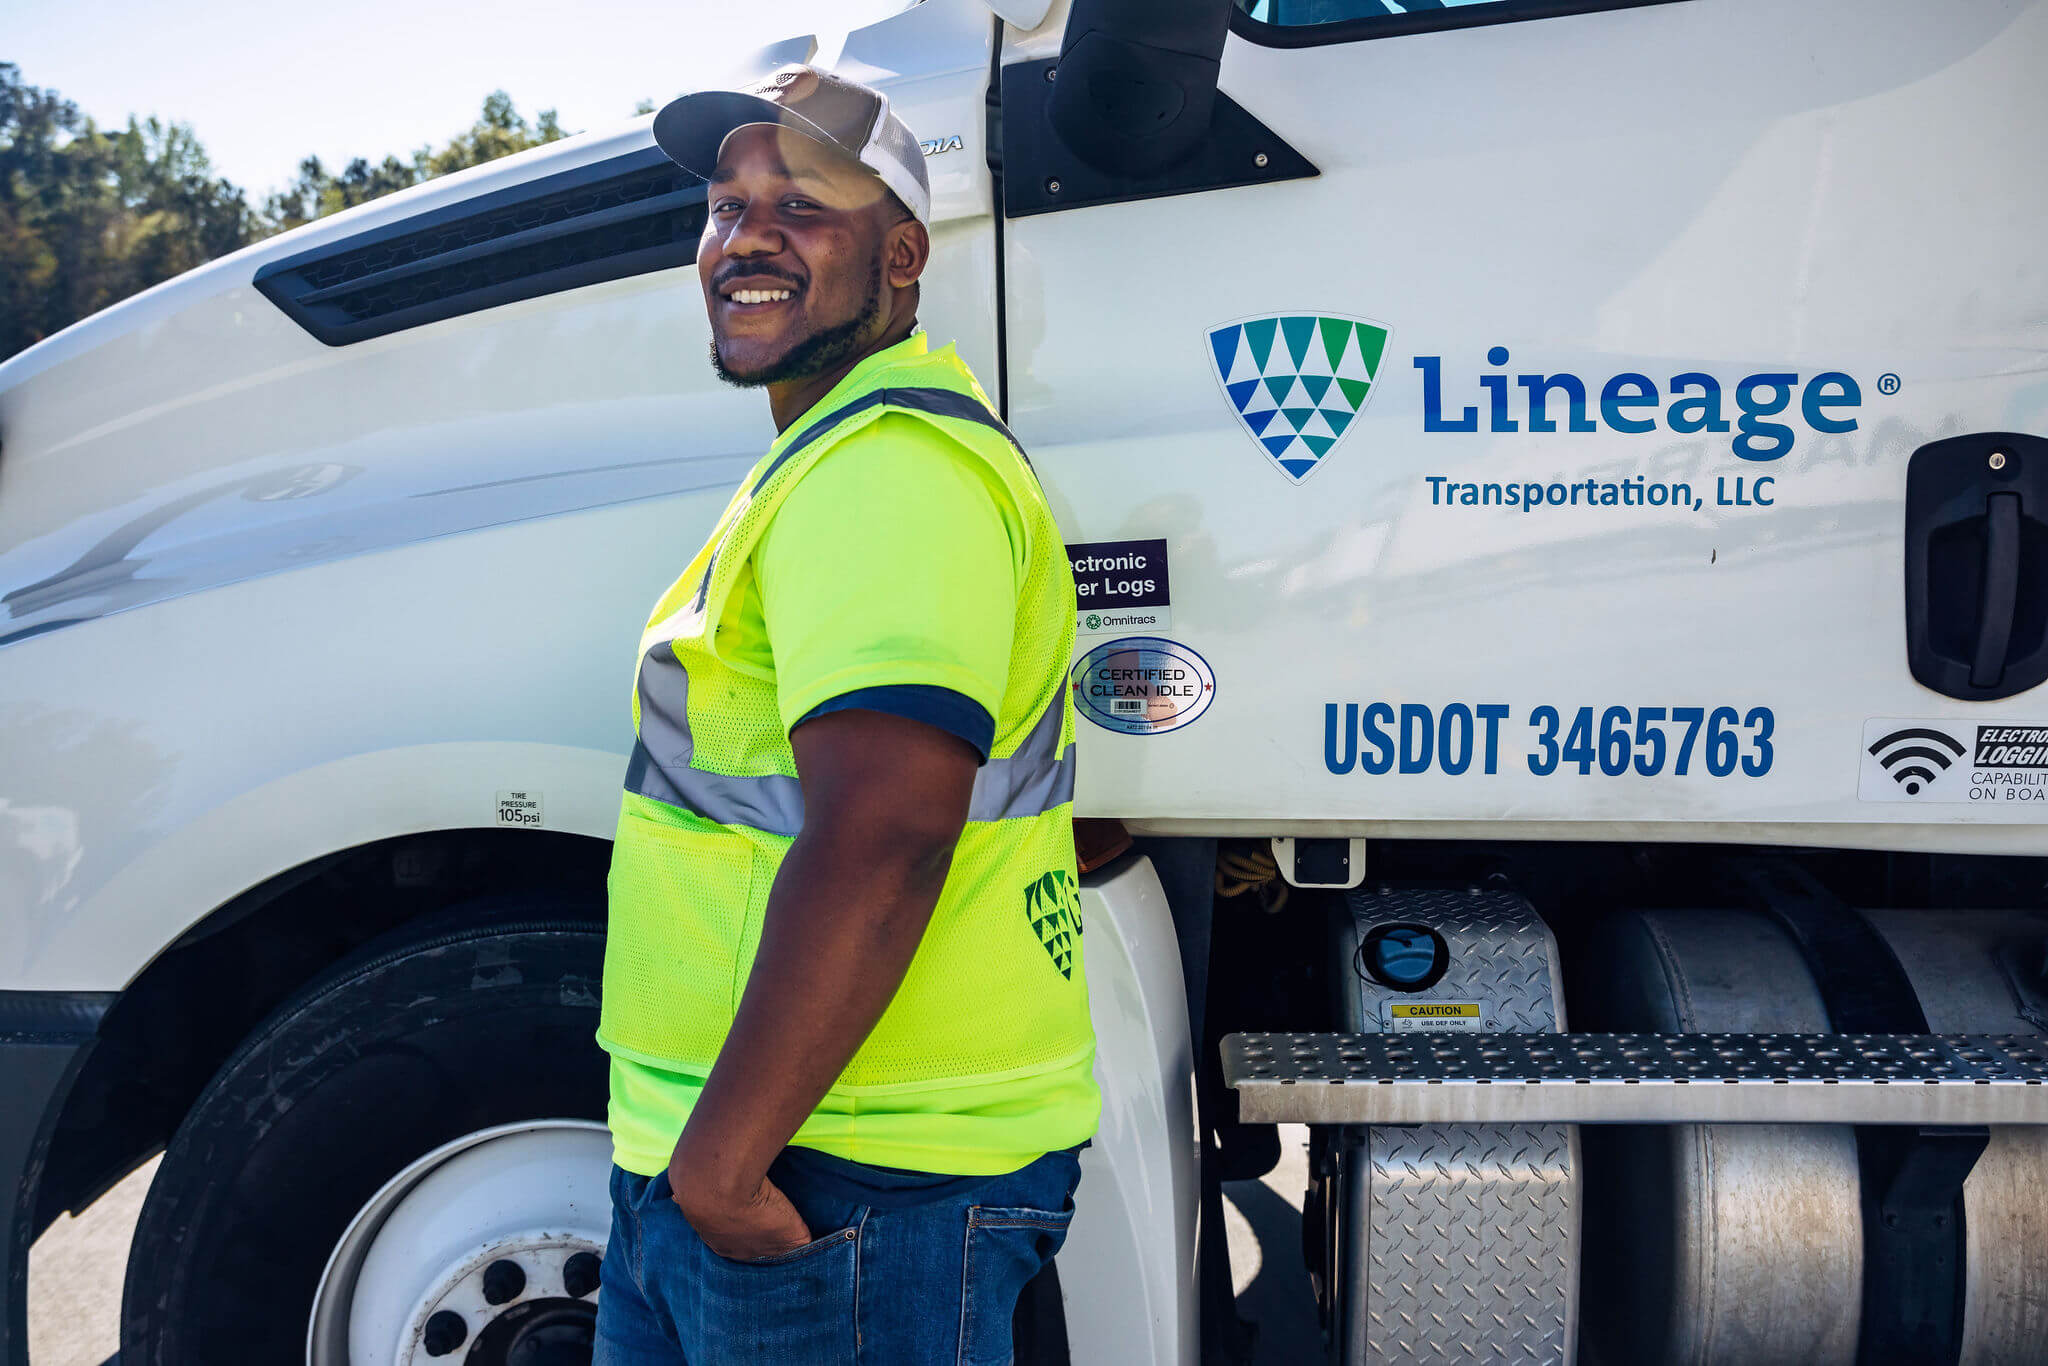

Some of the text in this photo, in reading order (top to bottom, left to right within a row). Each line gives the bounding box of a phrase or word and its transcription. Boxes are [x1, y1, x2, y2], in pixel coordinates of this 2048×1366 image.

[1412, 346, 1862, 462] Lineage
[1424, 476, 1776, 513] Transportation, LLC
[1104, 578, 1156, 598] Logs
[1103, 615, 1156, 626] Omnitracs
[1098, 668, 1186, 681] CERTIFIED
[1090, 684, 1194, 697] CLEAN IDLE
[1324, 703, 1776, 778] USDOT 3465763
[1969, 787, 2045, 801] ON BOA
[501, 800, 537, 808] PRESSURE
[498, 808, 540, 825] 105psi
[1410, 1006, 1462, 1016] CAUTION
